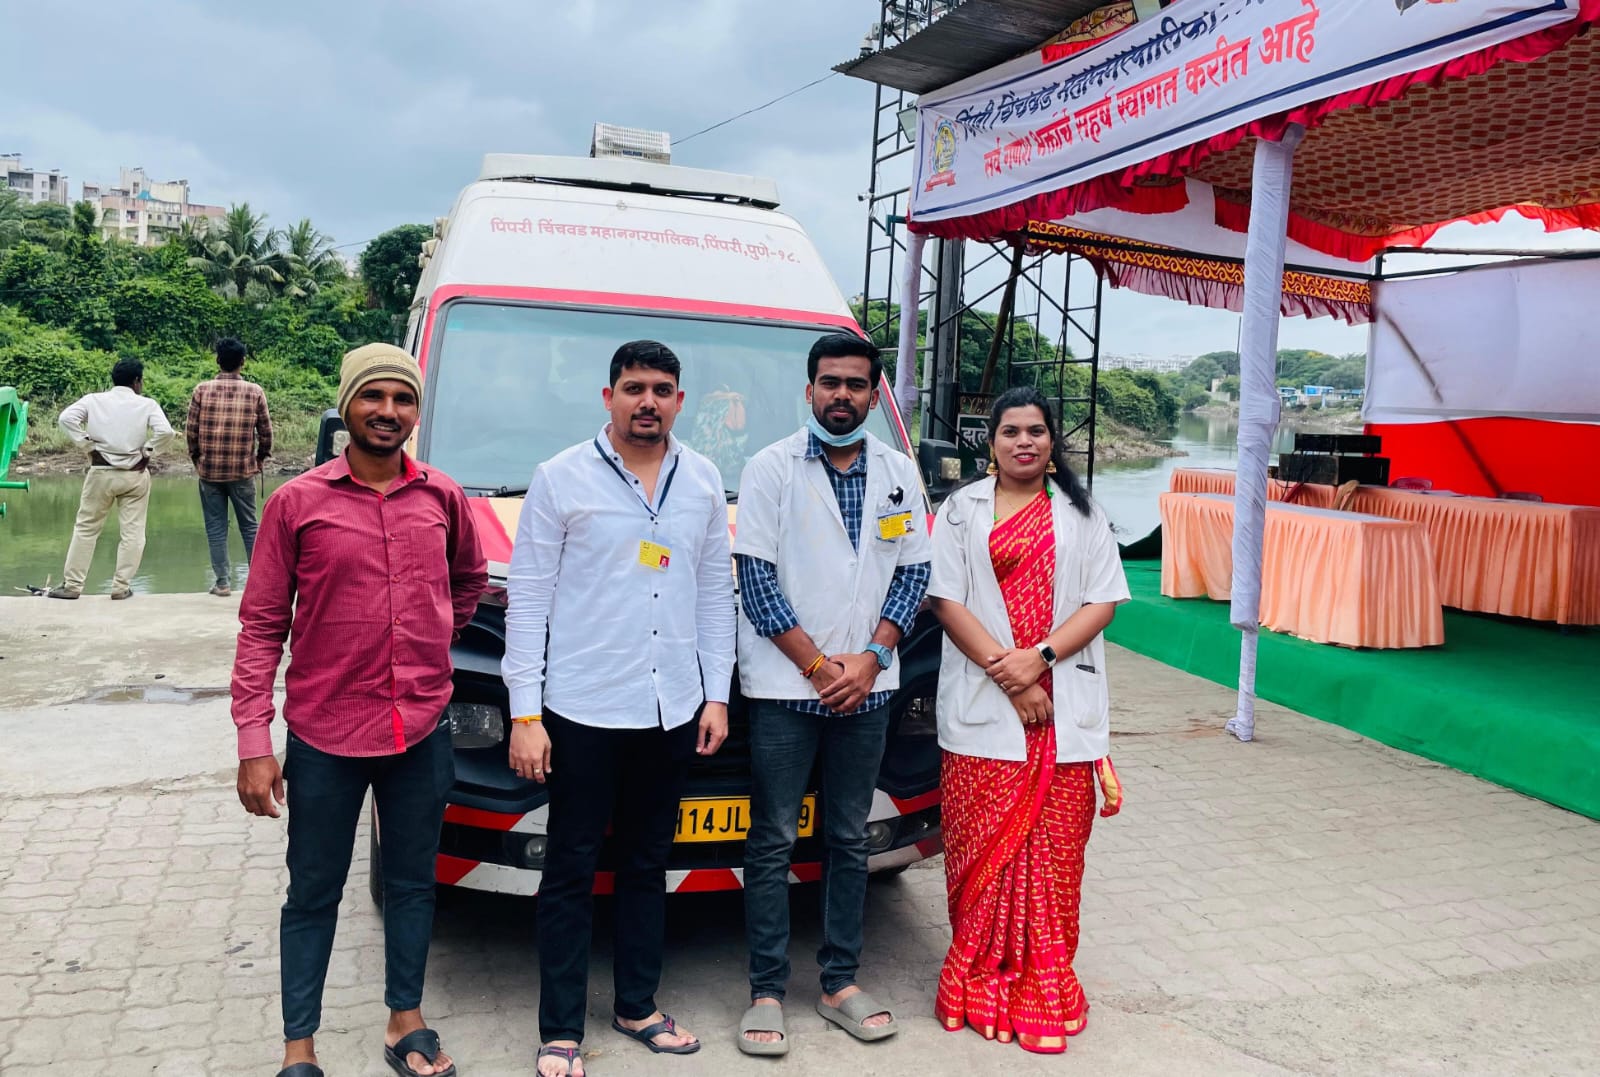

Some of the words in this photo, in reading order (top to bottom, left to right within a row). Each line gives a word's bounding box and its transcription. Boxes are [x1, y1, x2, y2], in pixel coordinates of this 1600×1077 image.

[1116, 67, 1180, 124] स्वागत
[1185, 35, 1252, 95] करीत
[1258, 0, 1320, 65] आहे
[538, 218, 588, 236] चिंचवड
